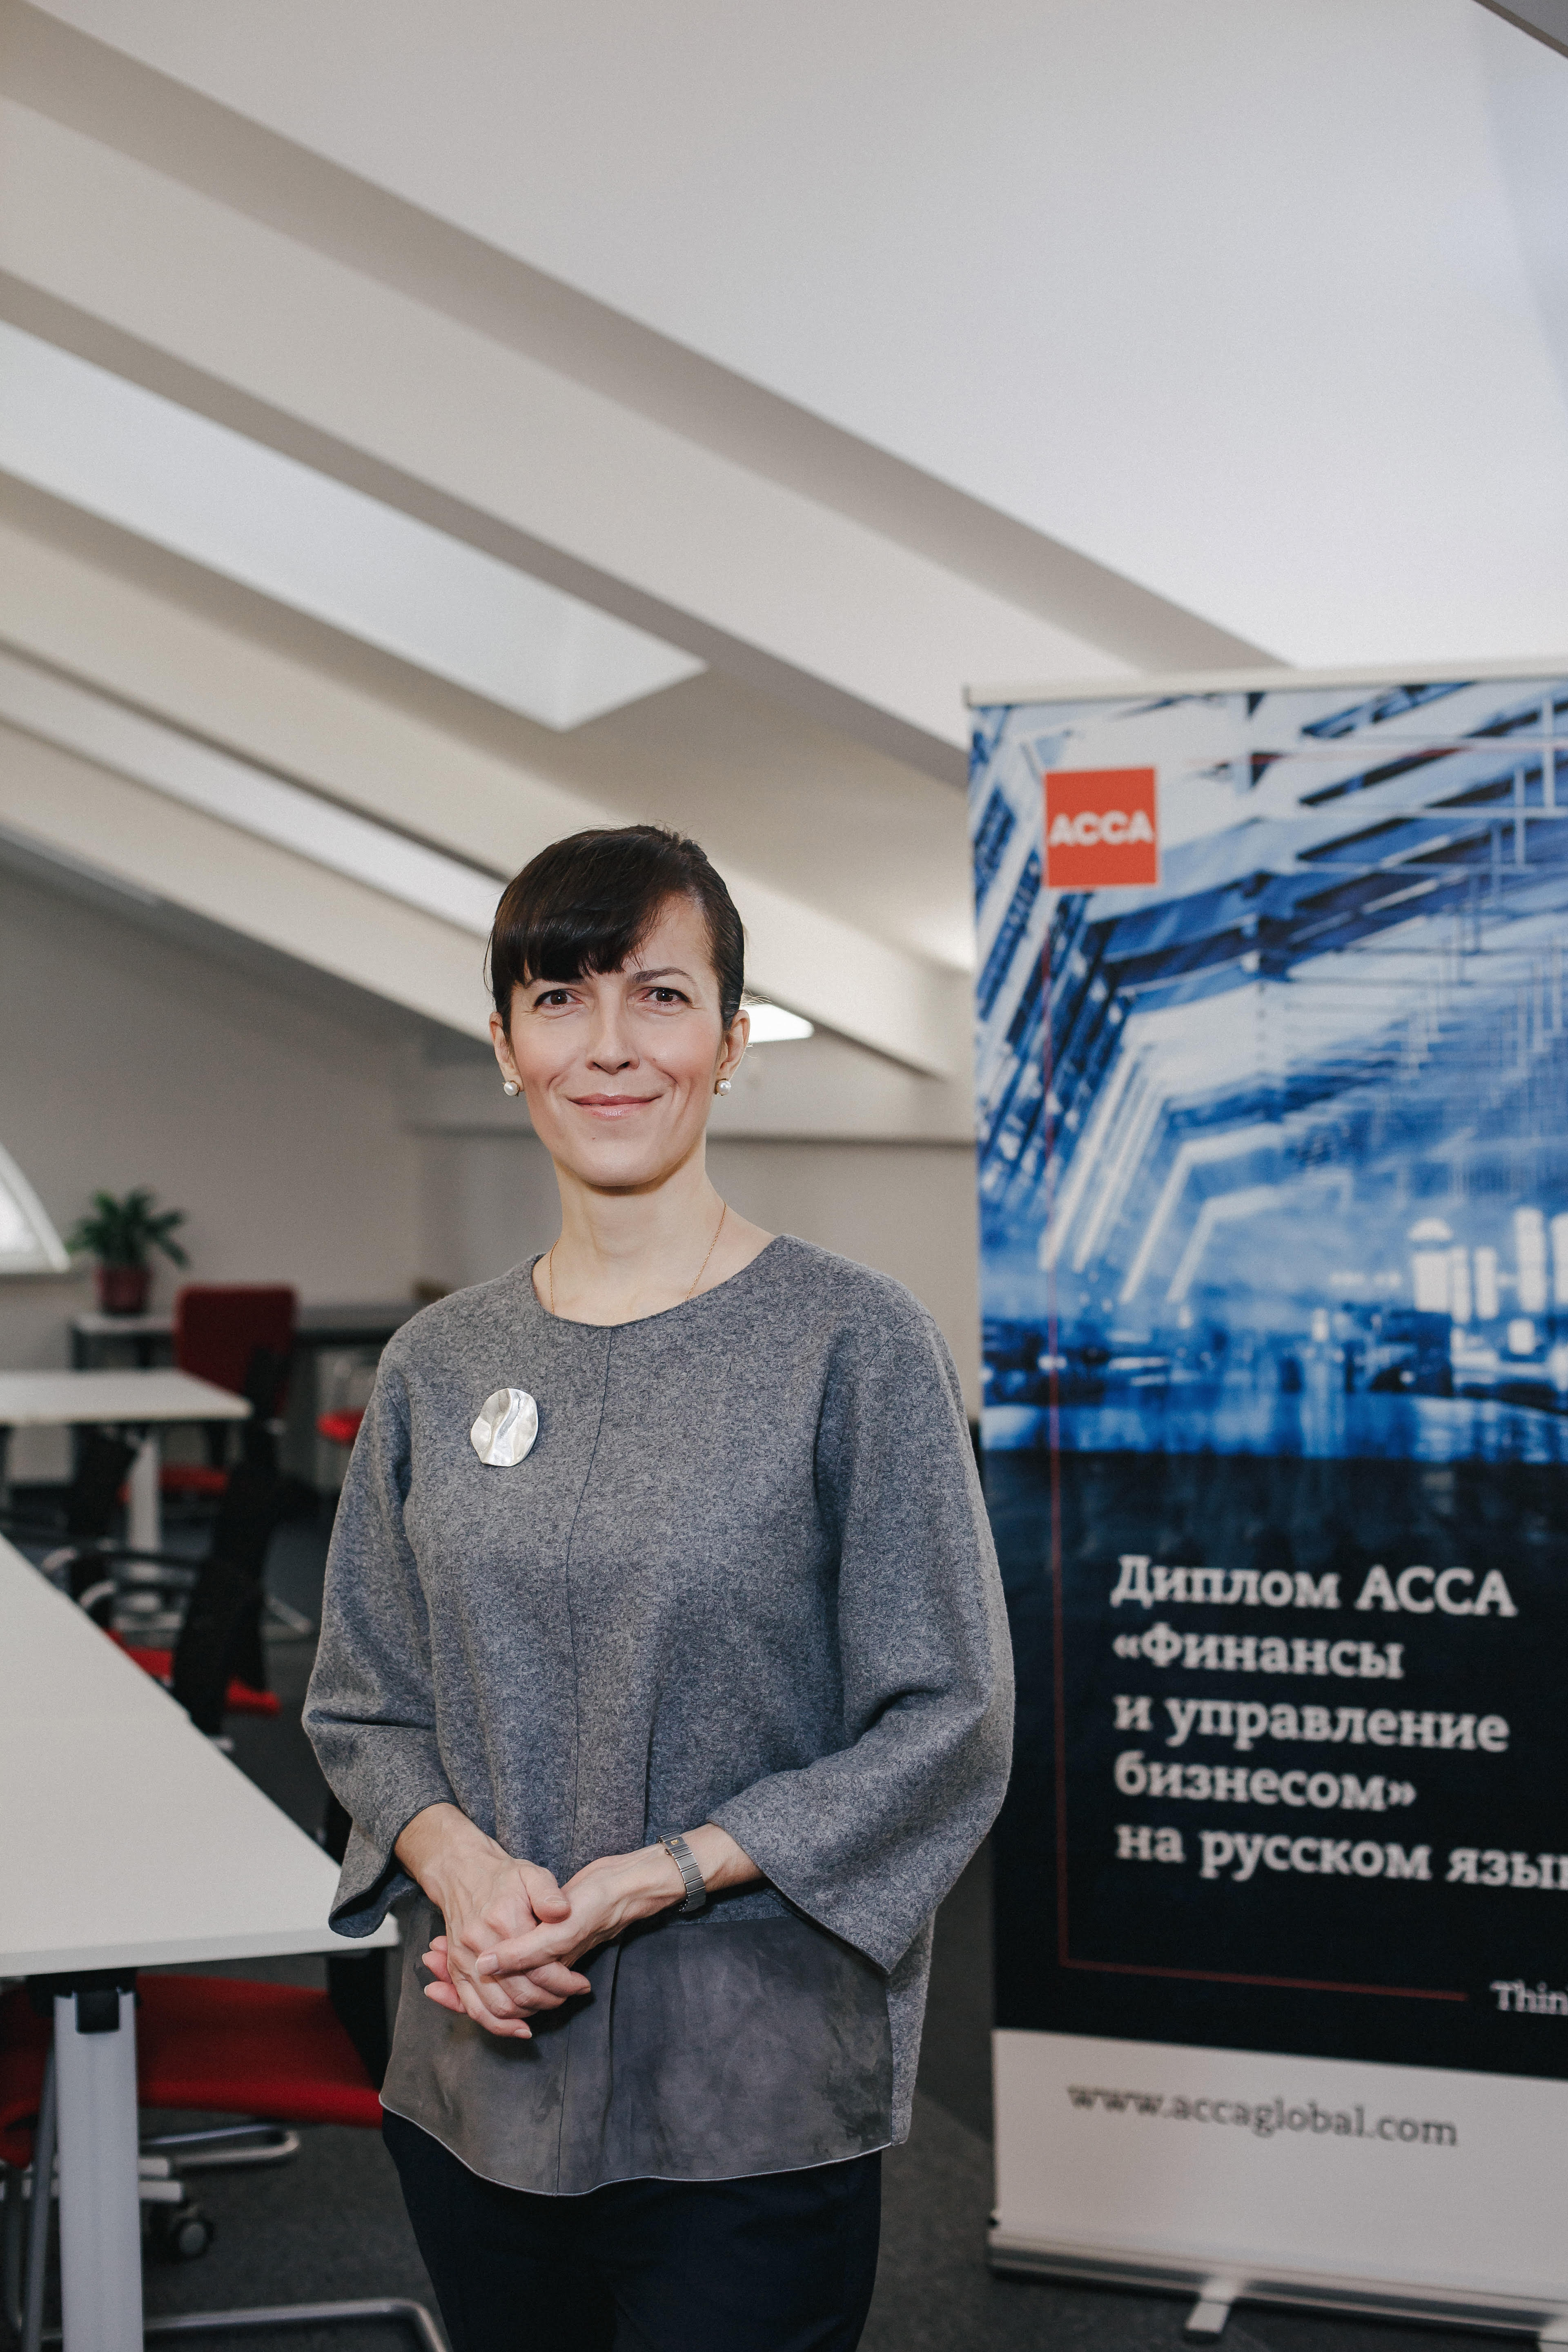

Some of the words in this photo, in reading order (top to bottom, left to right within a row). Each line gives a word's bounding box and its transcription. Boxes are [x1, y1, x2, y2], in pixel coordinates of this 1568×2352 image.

[1049, 809, 1153, 846] ACCA
[1109, 1554, 1340, 1609] Диплом
[1112, 1621, 1404, 1679] «Финансы
[1114, 1695, 1152, 1731] и
[1165, 1698, 1510, 1752] управление
[1114, 1750, 1417, 1811] бизнесом»
[1117, 1824, 1184, 1863] на
[1199, 1830, 1432, 1881] русском
[1446, 1848, 1568, 1890] язы
[1490, 1980, 1568, 2015] Thin
[1067, 2085, 1459, 2147] www.accaglobal.com
